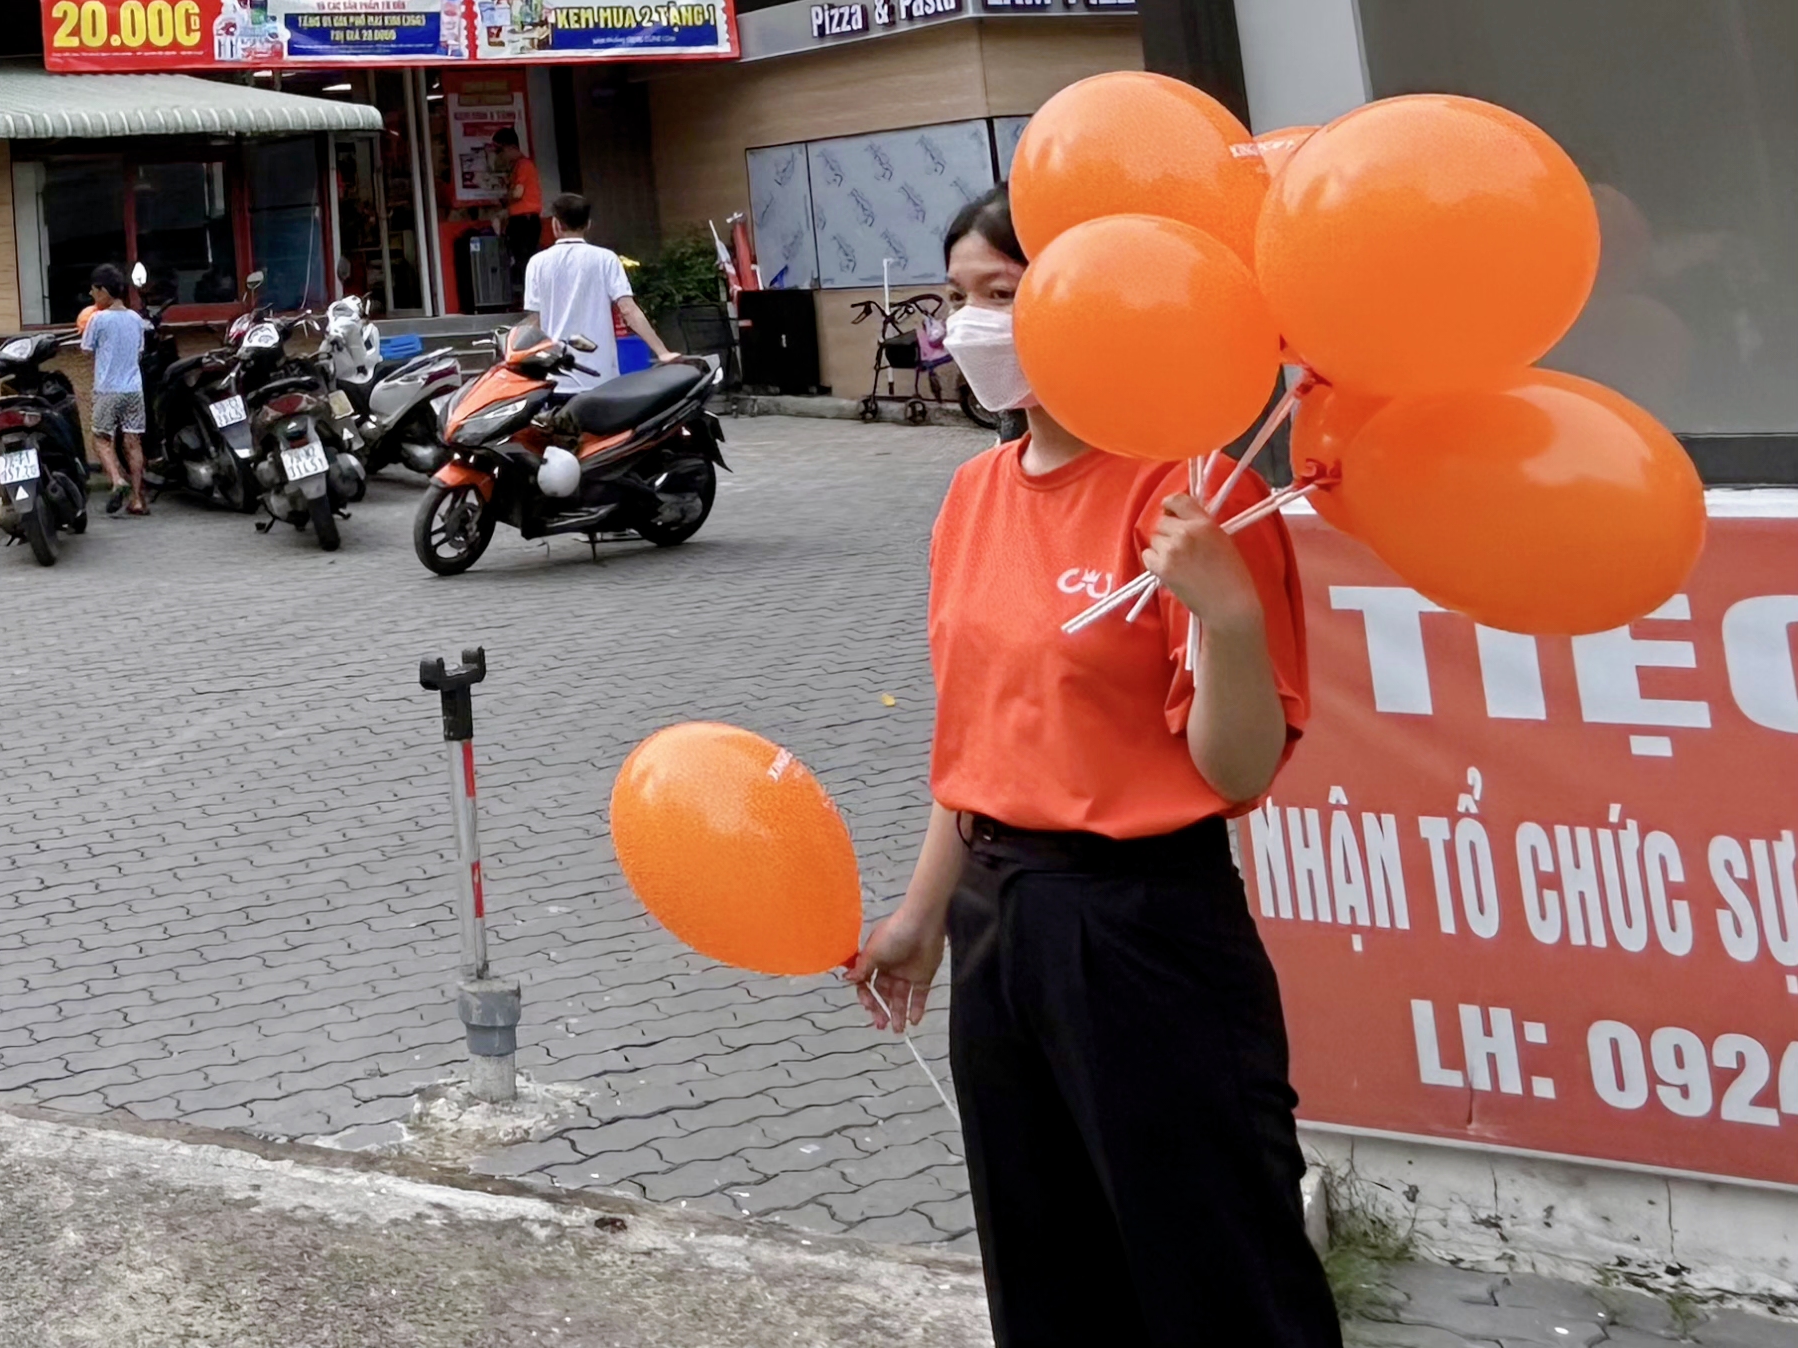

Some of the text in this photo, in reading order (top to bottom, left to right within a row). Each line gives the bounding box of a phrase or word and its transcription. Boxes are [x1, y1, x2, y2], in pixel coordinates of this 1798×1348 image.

[555, 1, 716, 33] KEM MUA 2 TẶNG 1
[810, 3, 864, 37] Pizza
[1248, 766, 1798, 995] NHẬN TỔ CHỨC SỰ
[1409, 998, 1557, 1100] LH:
